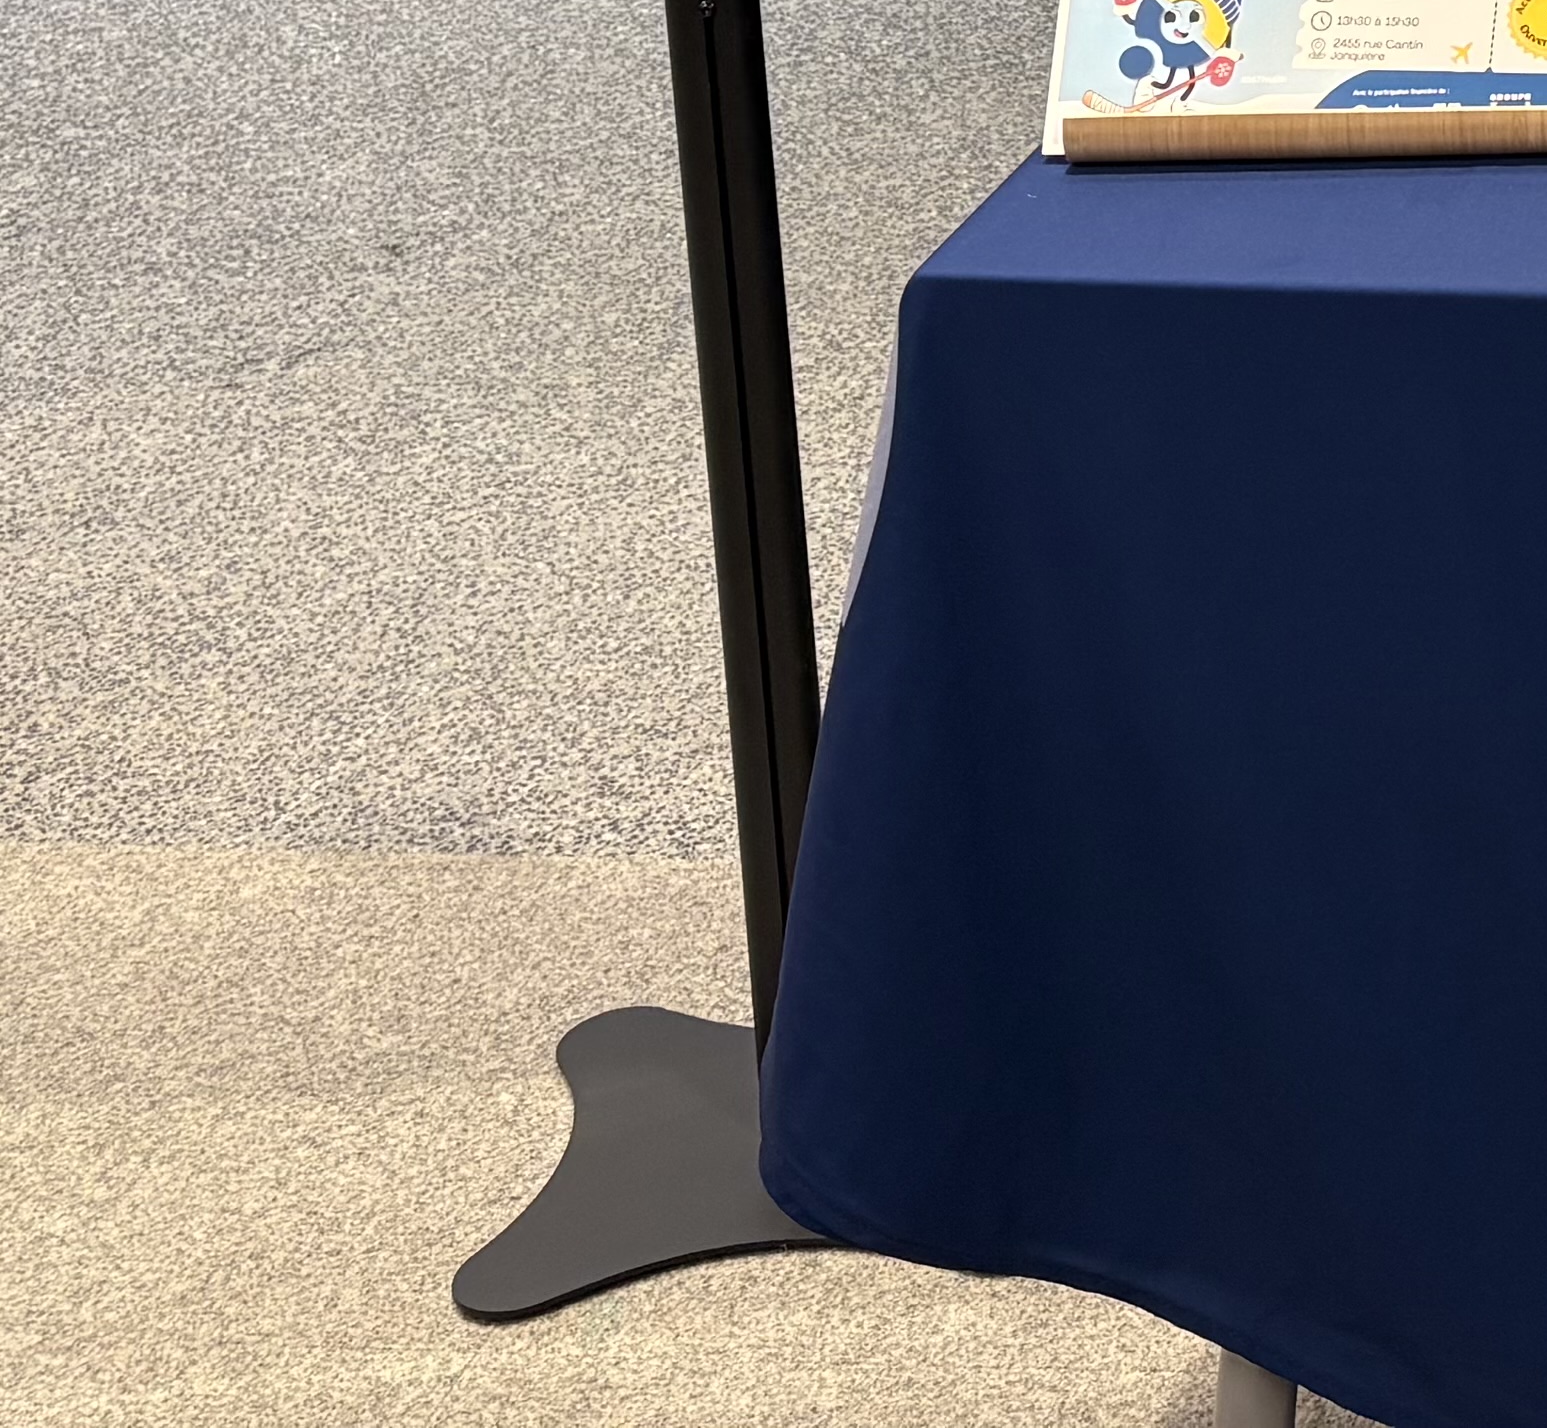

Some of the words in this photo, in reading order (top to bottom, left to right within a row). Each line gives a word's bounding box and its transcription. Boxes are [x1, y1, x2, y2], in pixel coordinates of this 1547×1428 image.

[1337, 15, 1372, 26] 13h30
[1385, 16, 1420, 27] 15h30
[1332, 37, 1361, 49] 2455
[1363, 41, 1383, 49] rue
